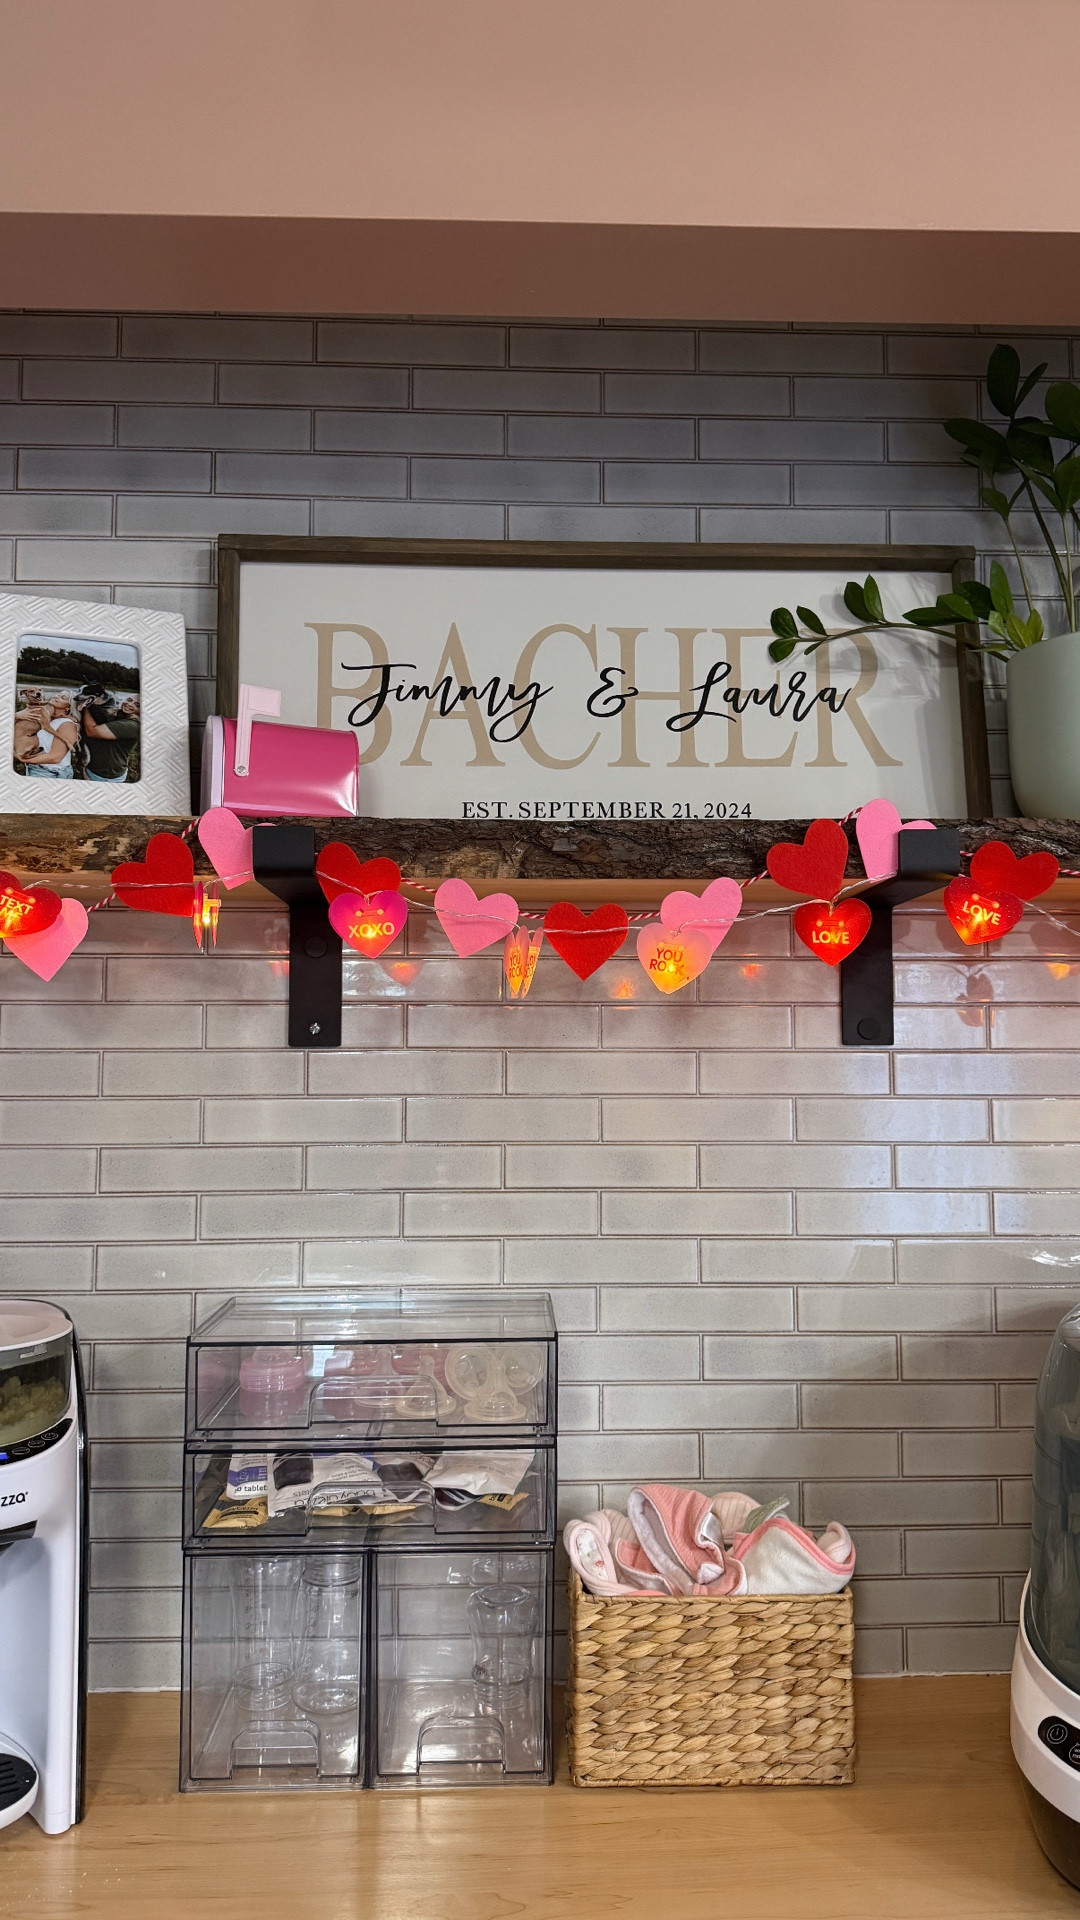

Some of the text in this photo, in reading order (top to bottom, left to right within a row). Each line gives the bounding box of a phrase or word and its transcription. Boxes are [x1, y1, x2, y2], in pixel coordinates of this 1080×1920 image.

[304, 622, 903, 769] BACHER
[341, 661, 852, 743] Jimmy & Laura
[462, 801, 752, 820] EST. SEPTEMBER 21, 2024
[0, 894, 34, 915] TEXT
[962, 900, 1001, 926] LOVE
[348, 922, 395, 939] XOXO
[812, 930, 850, 945] LOVE
[656, 947, 683, 963] YOU
[649, 958, 685, 976] ROK
